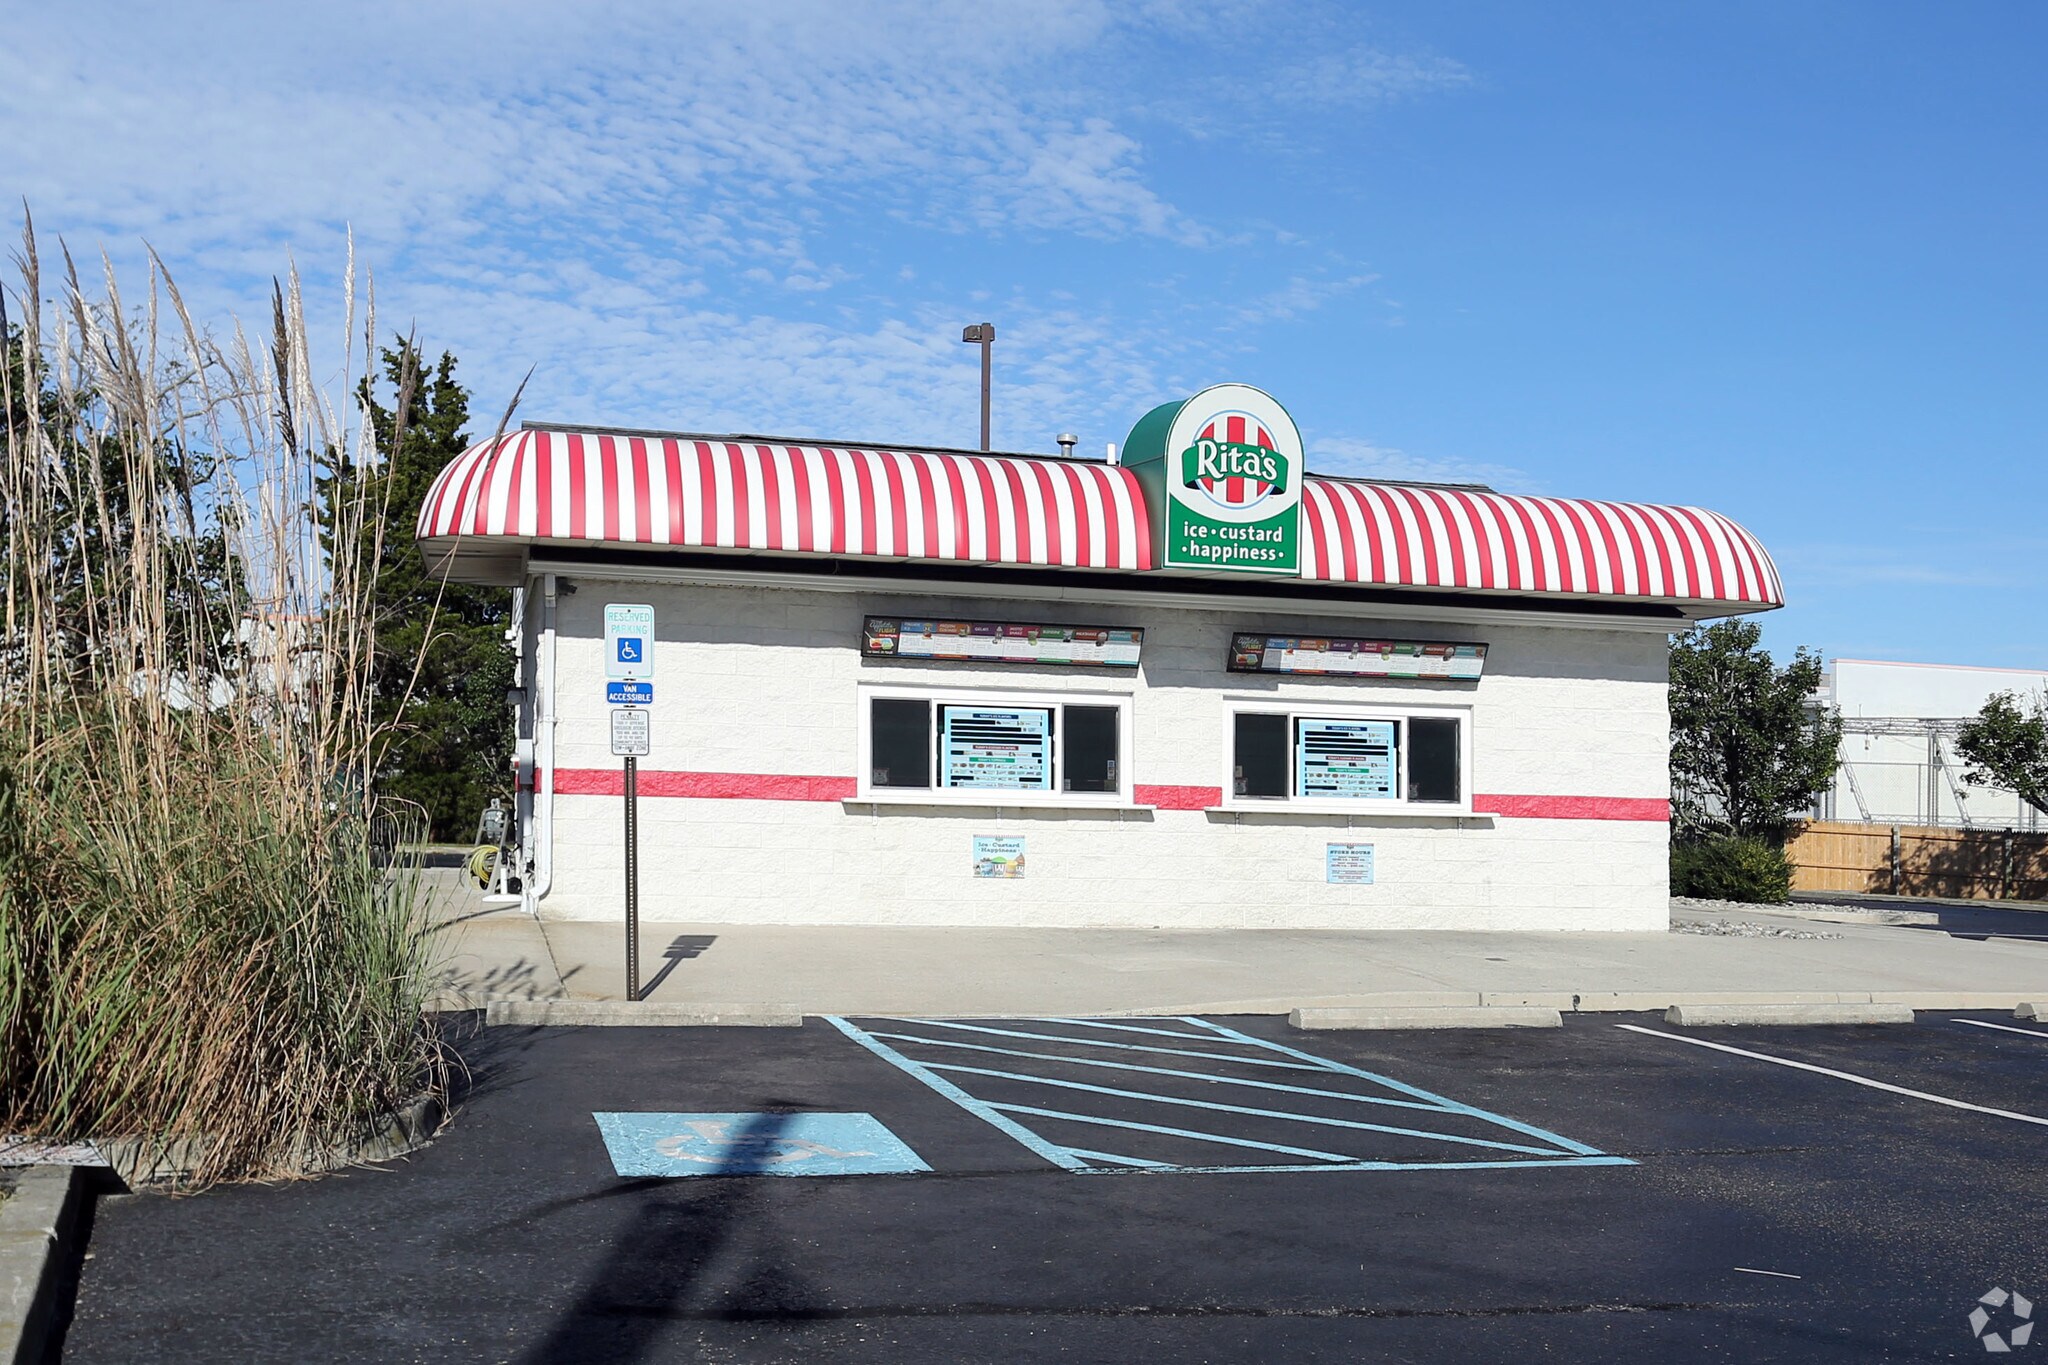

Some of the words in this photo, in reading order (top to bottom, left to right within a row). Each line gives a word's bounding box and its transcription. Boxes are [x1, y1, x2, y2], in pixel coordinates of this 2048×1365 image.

[1197, 438, 1278, 481] Rita's
[1184, 521, 1208, 537] ice
[1219, 526, 1283, 542] custard
[1190, 540, 1276, 562] happiness
[608, 612, 650, 622] RESERVED
[611, 624, 648, 634] PARKING
[623, 685, 637, 693] VAN
[608, 693, 651, 702] ACCESSIBLE
